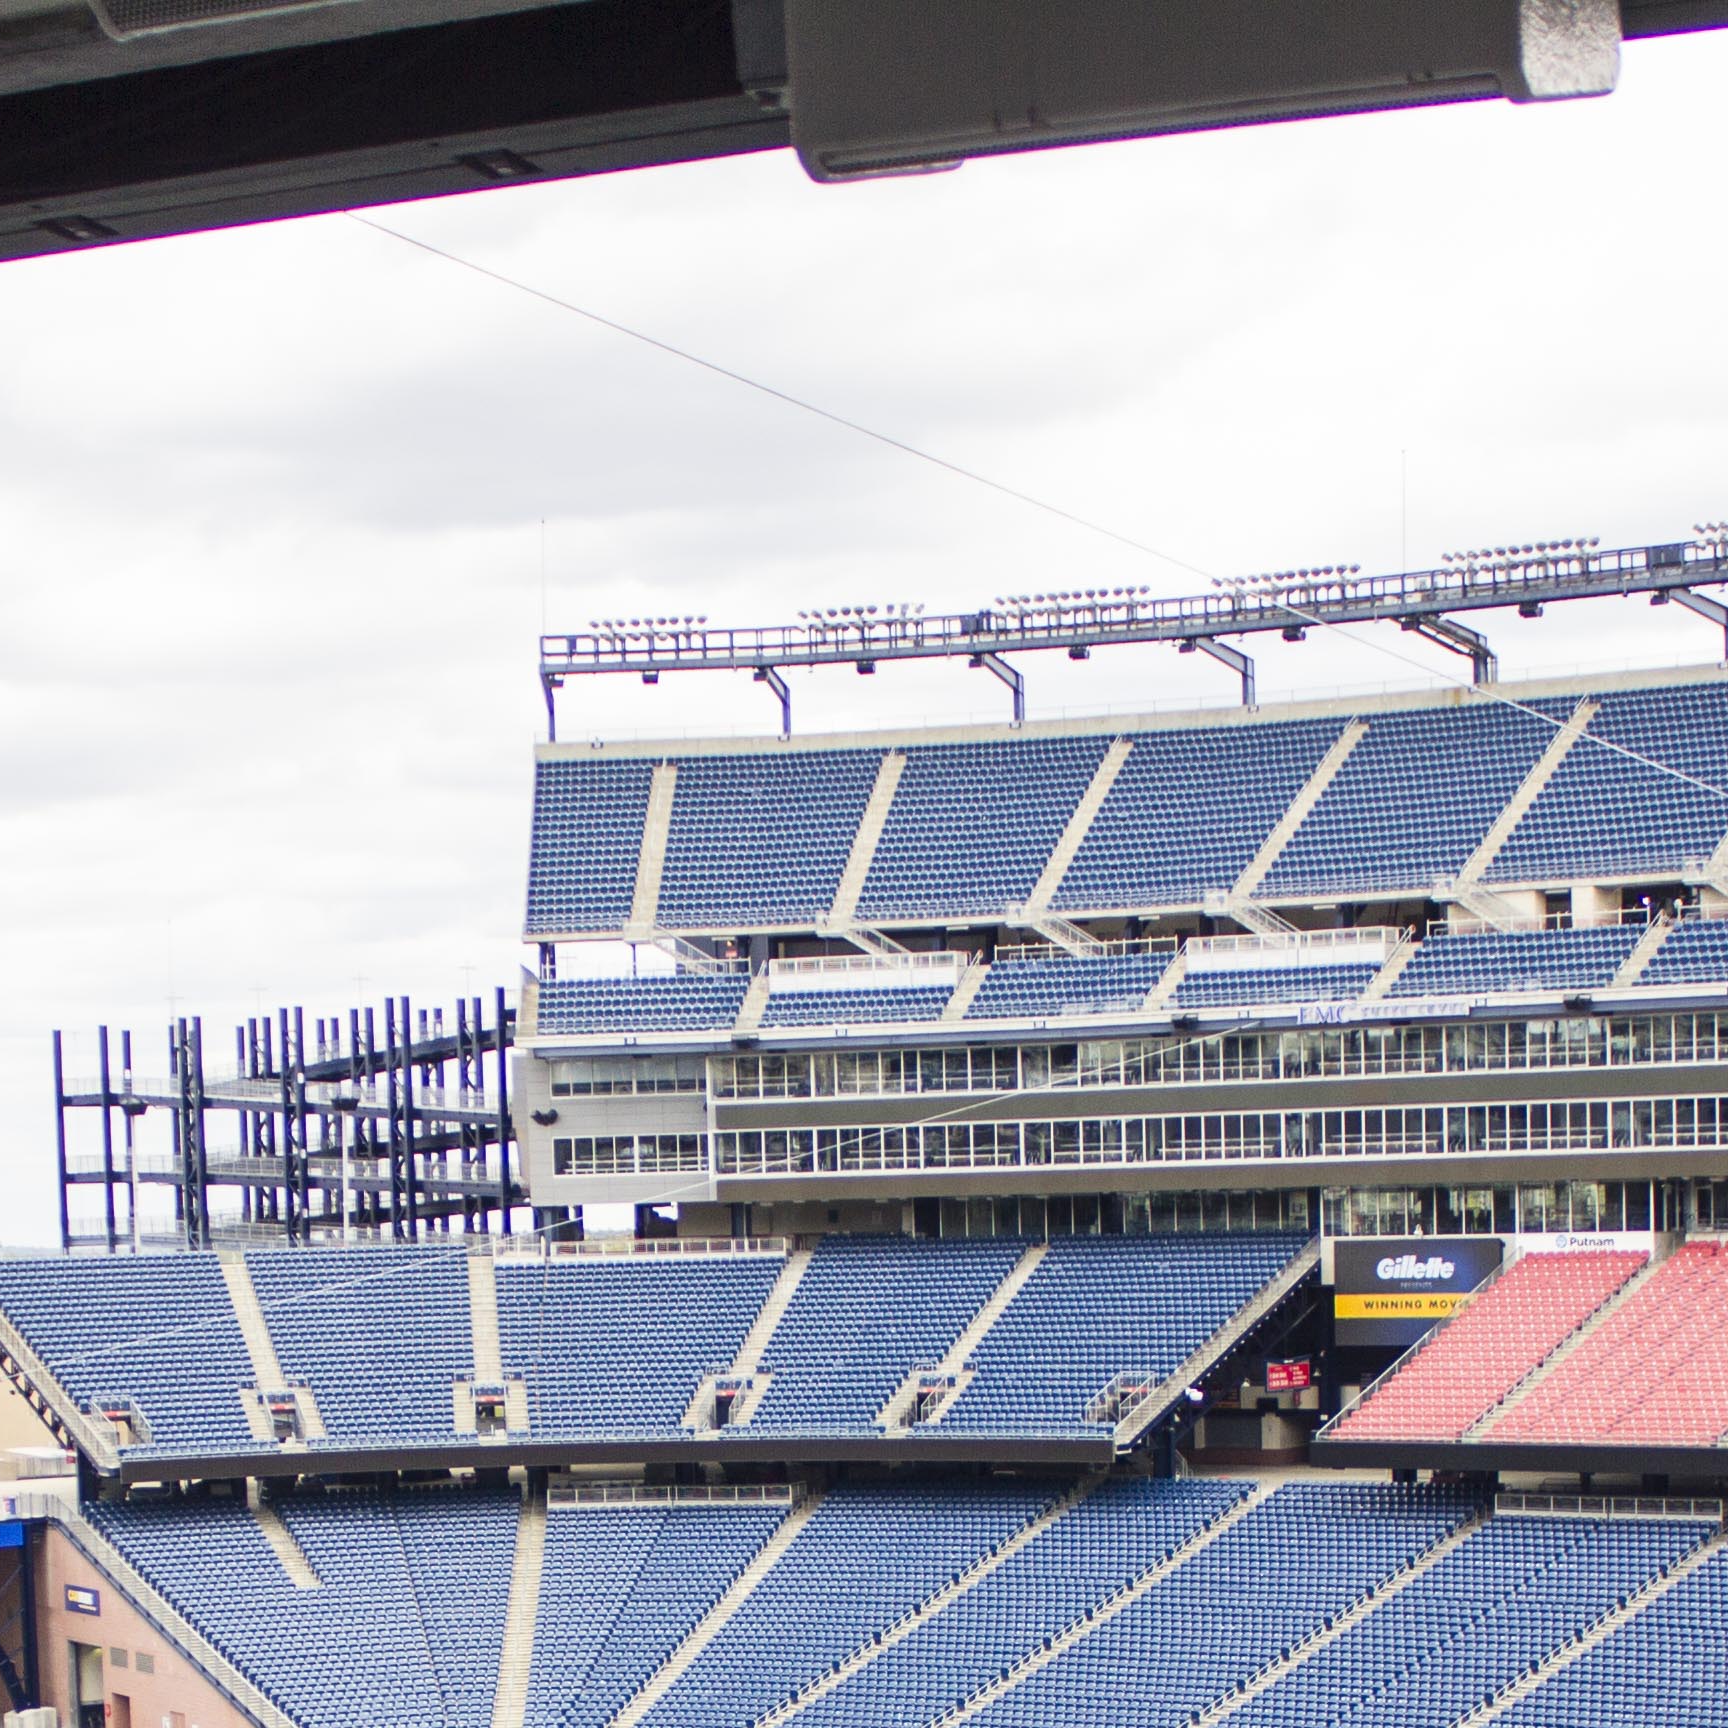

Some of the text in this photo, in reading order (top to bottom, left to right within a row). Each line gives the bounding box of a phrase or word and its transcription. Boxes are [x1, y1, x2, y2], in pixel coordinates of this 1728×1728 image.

[1569, 1237, 1615, 1247] Putnam
[1376, 1255, 1456, 1280] Gillette
[1363, 1300, 1423, 1310] WINNING
